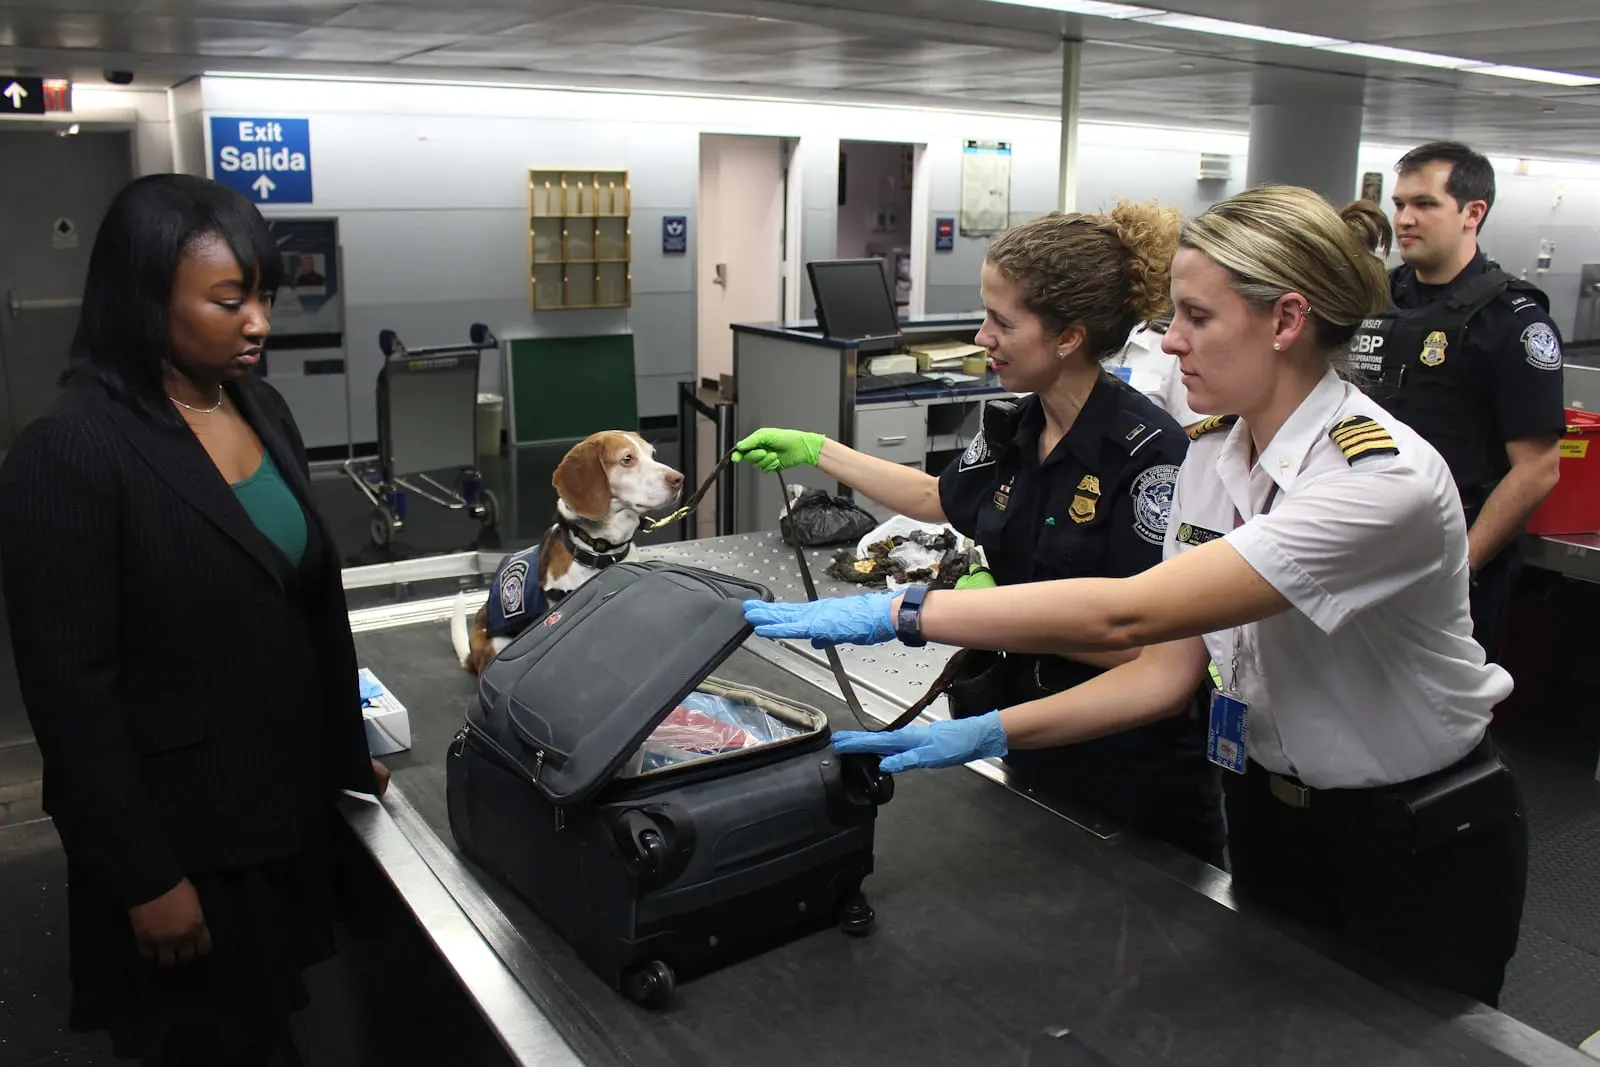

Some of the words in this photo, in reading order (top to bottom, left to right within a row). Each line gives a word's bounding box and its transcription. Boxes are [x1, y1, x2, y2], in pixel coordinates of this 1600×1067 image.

[239, 121, 283, 142] Exit
[220, 146, 305, 171] Salida
[1350, 334, 1384, 353] CBP
[1355, 355, 1382, 364] OPERATIONS
[1360, 362, 1381, 371] OFFICER
